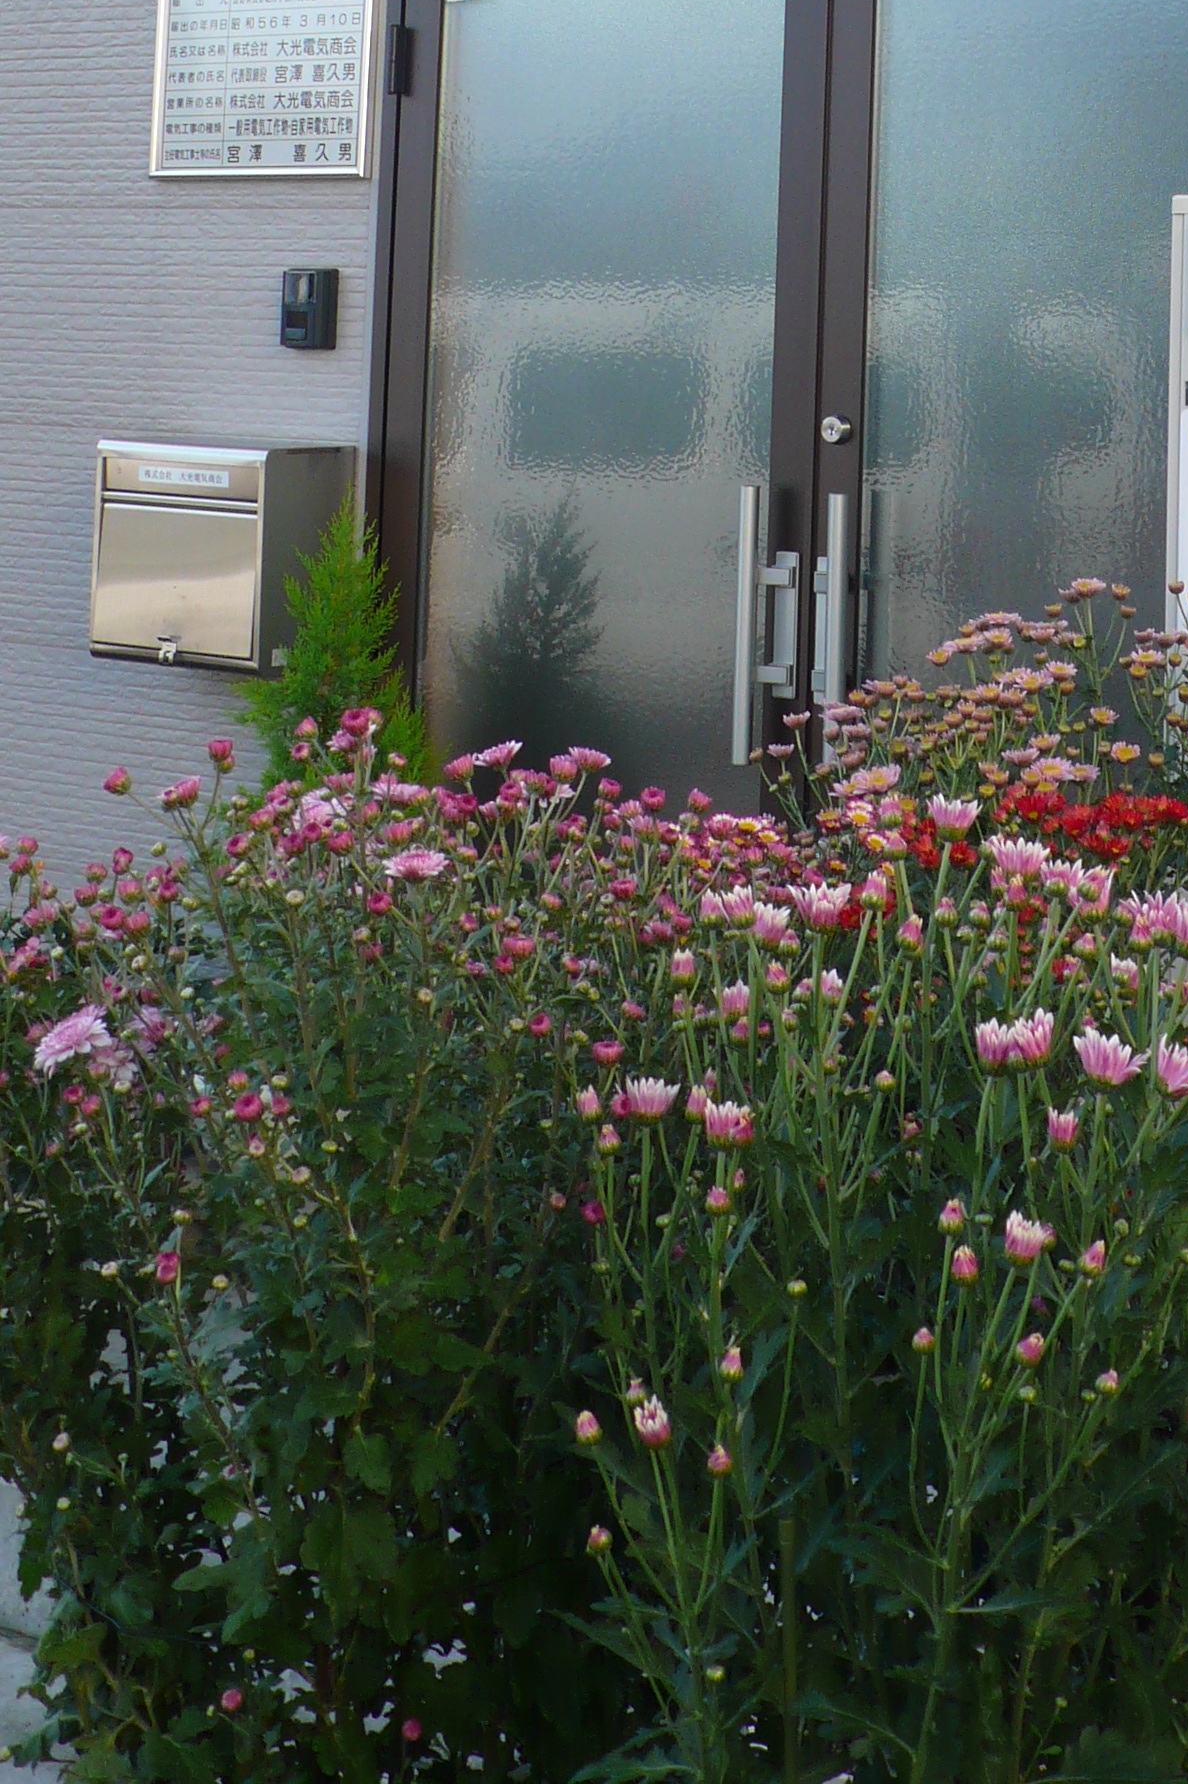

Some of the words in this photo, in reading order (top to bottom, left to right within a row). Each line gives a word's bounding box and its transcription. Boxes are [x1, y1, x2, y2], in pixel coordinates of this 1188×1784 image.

[232, 41, 268, 57] 株式会社
[276, 36, 357, 56] 大光電気商会
[274, 65, 303, 84] 宮澤
[312, 63, 356, 82] 喜久男
[230, 94, 265, 109] 株式会社
[273, 89, 354, 109] 大光電気商会
[227, 144, 263, 164] 宮澤
[293, 143, 352, 162] 喜久男
